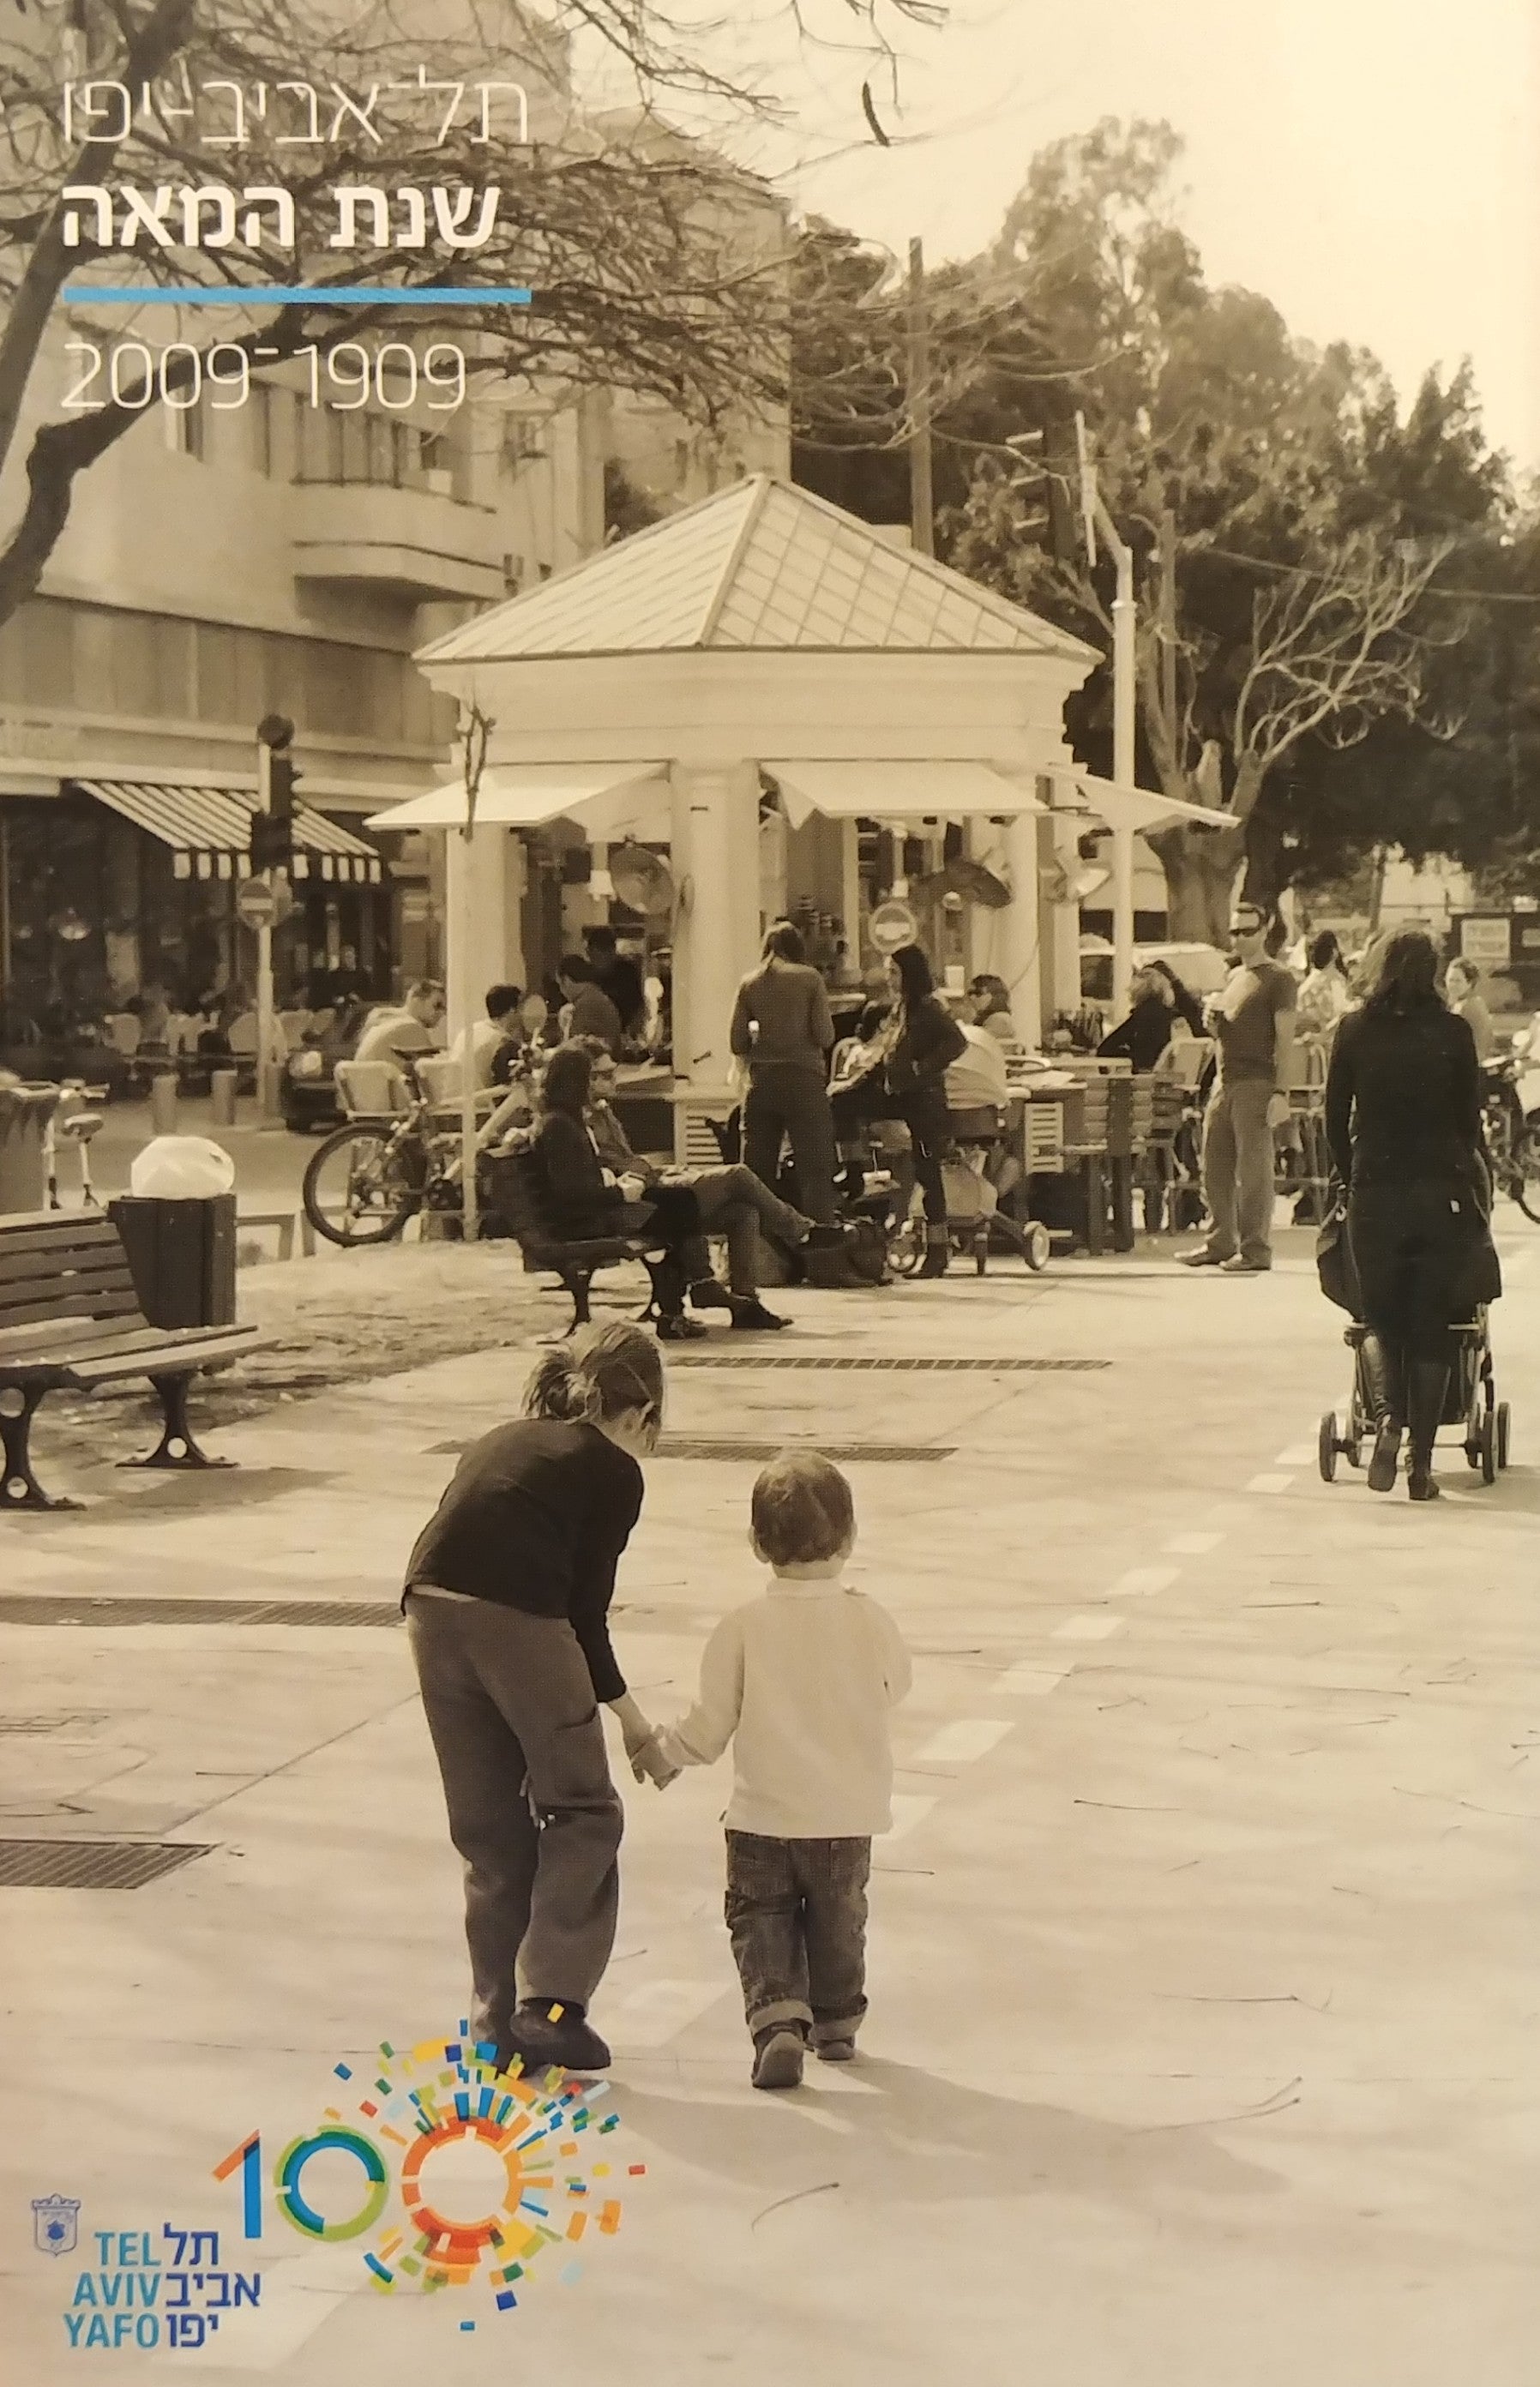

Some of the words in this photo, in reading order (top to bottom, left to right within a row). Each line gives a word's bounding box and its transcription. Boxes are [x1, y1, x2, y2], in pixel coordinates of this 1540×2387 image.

[62, 185, 295, 247] המאה
[330, 186, 500, 248] שנת
[93, 2231, 162, 2267] TEL
[163, 2222, 220, 2265] תל
[72, 2272, 161, 2307] AVIV
[165, 2272, 262, 2308] אביב
[63, 2312, 160, 2349] YAFO
[165, 2313, 220, 2349] יפו
